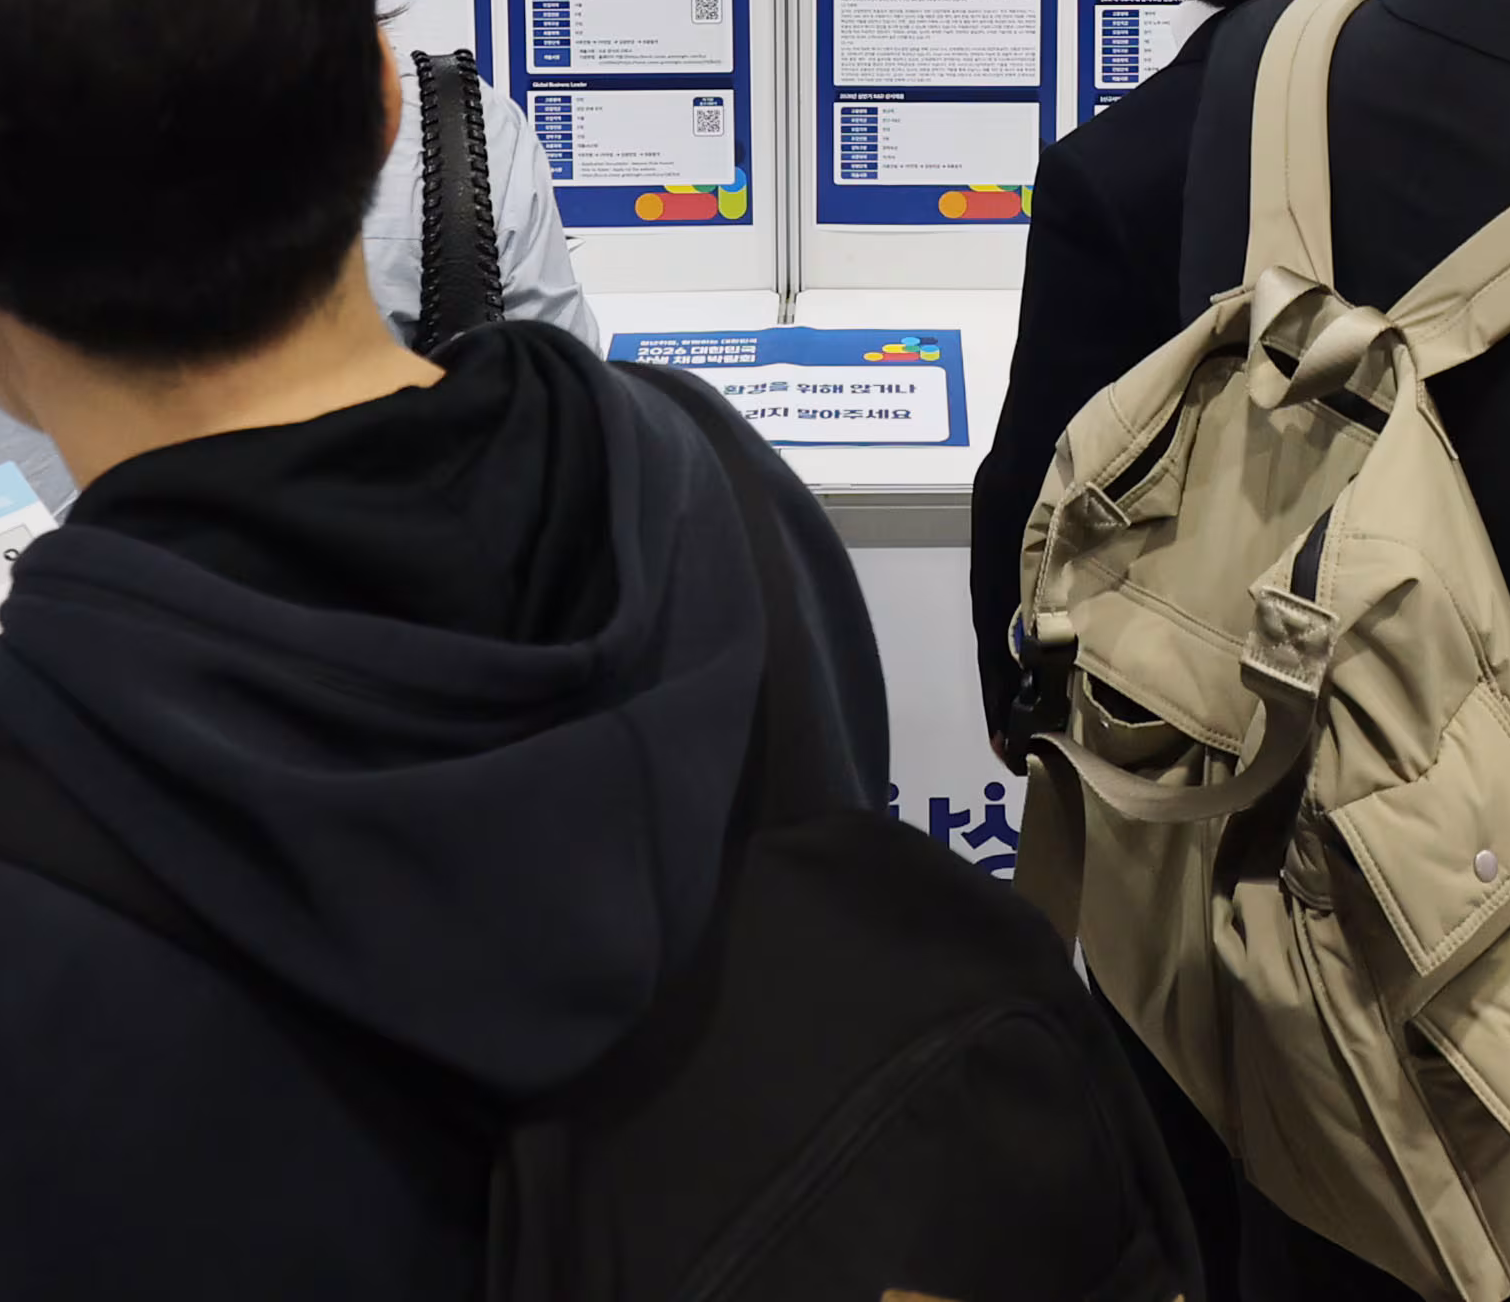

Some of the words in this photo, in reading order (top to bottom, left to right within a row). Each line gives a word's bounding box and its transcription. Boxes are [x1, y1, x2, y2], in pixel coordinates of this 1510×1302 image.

[638, 347, 687, 356] 2026
[691, 345, 756, 355] 대한민국
[673, 354, 756, 364] 채용박람회
[724, 381, 789, 395] 환경을
[797, 384, 844, 394] 위해
[850, 384, 917, 394] 앉거나
[740, 407, 789, 420] 리지
[797, 408, 912, 420] 말아주세요
